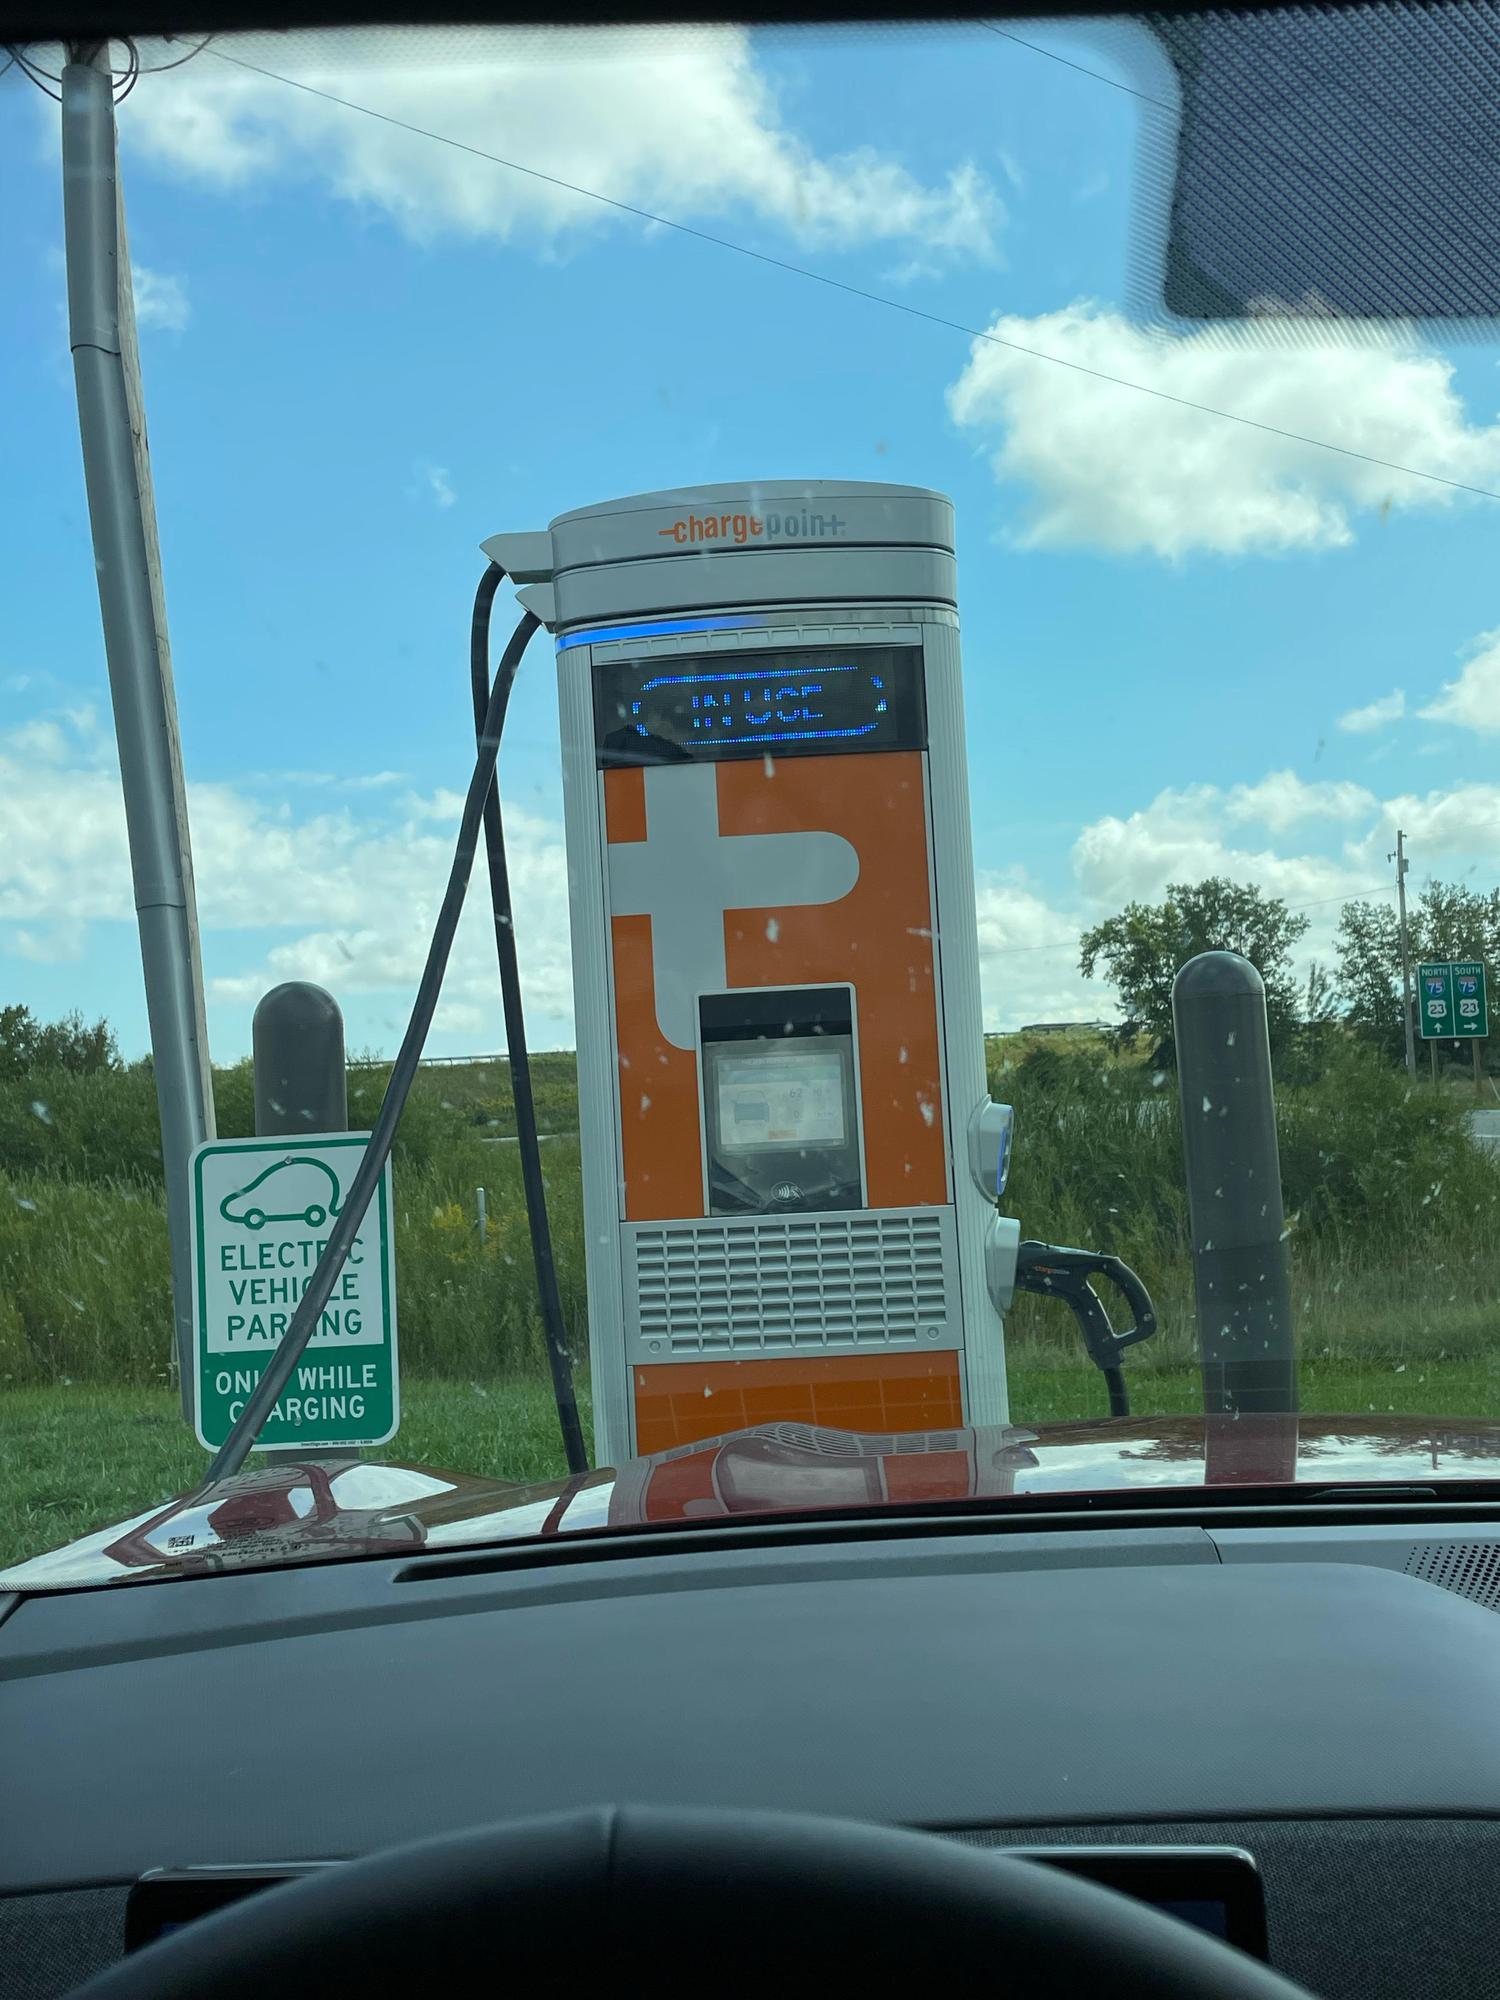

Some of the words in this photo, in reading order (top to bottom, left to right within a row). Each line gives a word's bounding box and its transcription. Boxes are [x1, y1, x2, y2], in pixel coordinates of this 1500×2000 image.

[1421, 967, 1448, 977] NORTH
[1454, 966, 1481, 976] SOUTH
[1428, 982, 1443, 994] 75
[1460, 981, 1476, 993] 75
[1430, 1004, 1445, 1015] 23
[1462, 1003, 1477, 1014] 23
[221, 1238, 364, 1272] ELECTC
[229, 1273, 360, 1306] VEHIE
[227, 1309, 362, 1341] PARNG
[215, 1370, 263, 1395] ON
[298, 1364, 378, 1391] WHILE
[229, 1395, 365, 1425] CARGING
